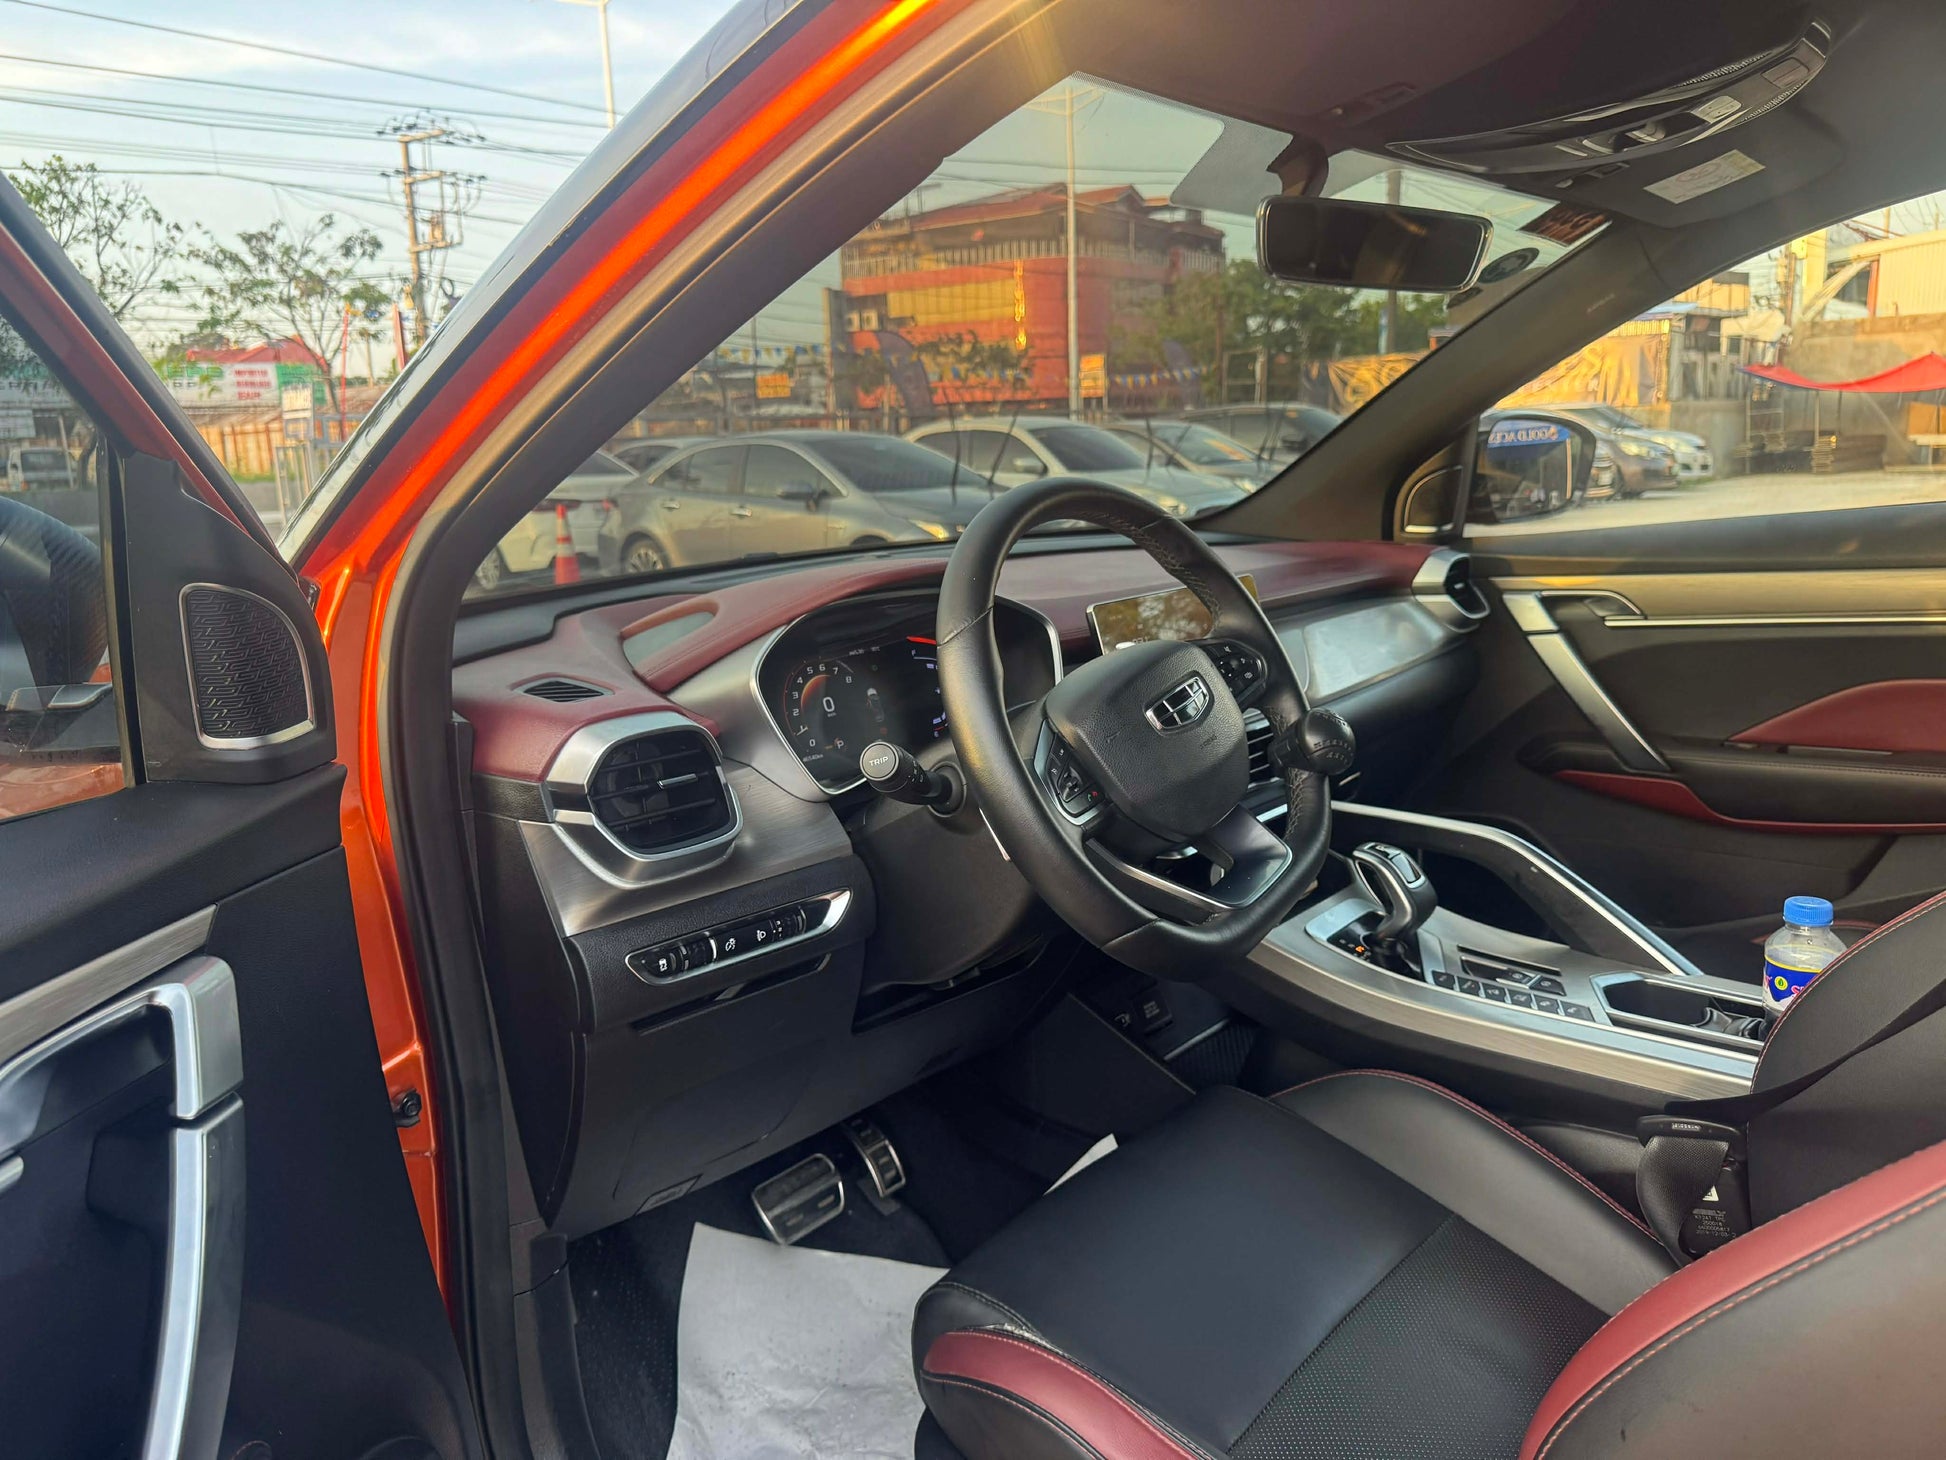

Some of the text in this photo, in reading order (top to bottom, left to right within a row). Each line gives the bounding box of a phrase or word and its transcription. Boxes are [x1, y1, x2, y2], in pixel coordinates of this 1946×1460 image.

[806, 666, 814, 674] 5
[819, 663, 826, 671] 6
[832, 667, 838, 675] 7
[797, 676, 803, 684] 4
[845, 676, 852, 684] 8
[792, 691, 799, 699] 3
[823, 697, 835, 712] 0
[792, 708, 799, 716] 2
[809, 738, 816, 747] 0
[837, 740, 844, 749] P
[869, 756, 889, 766] TRIP
